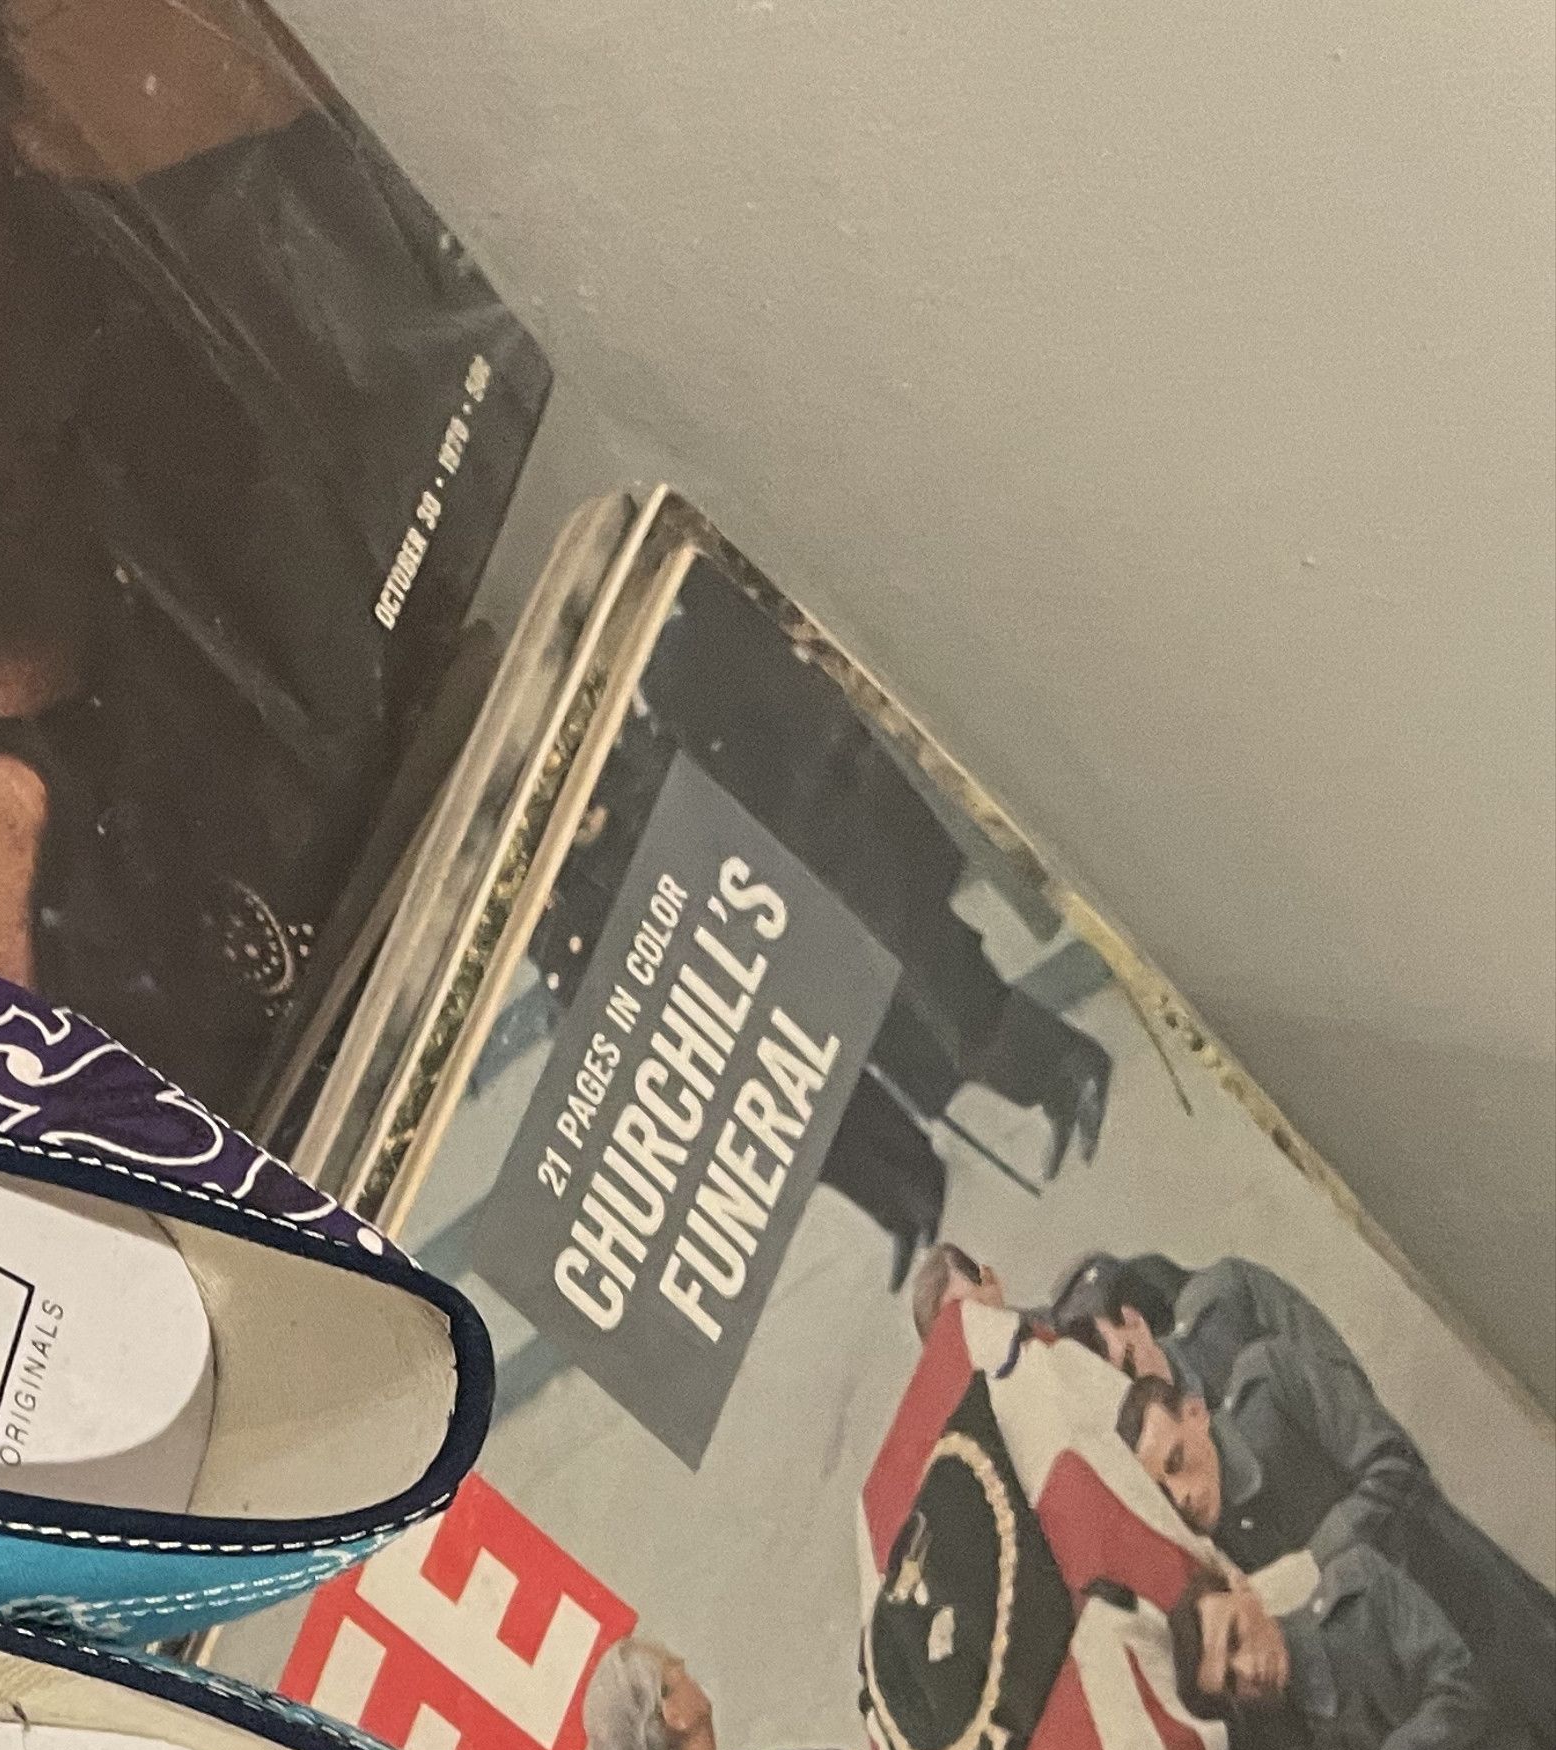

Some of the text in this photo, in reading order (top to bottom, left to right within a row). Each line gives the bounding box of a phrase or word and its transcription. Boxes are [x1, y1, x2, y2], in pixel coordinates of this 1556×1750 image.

[375, 527, 428, 630] OCTOBER
[416, 491, 441, 530] 30
[537, 873, 688, 1197] 21 PAGES IN COLOR
[555, 856, 787, 1331] CHURCHILL'S
[659, 1007, 840, 1344] FUNERAL
[0, 1299, 65, 1468] ORIGINALS
